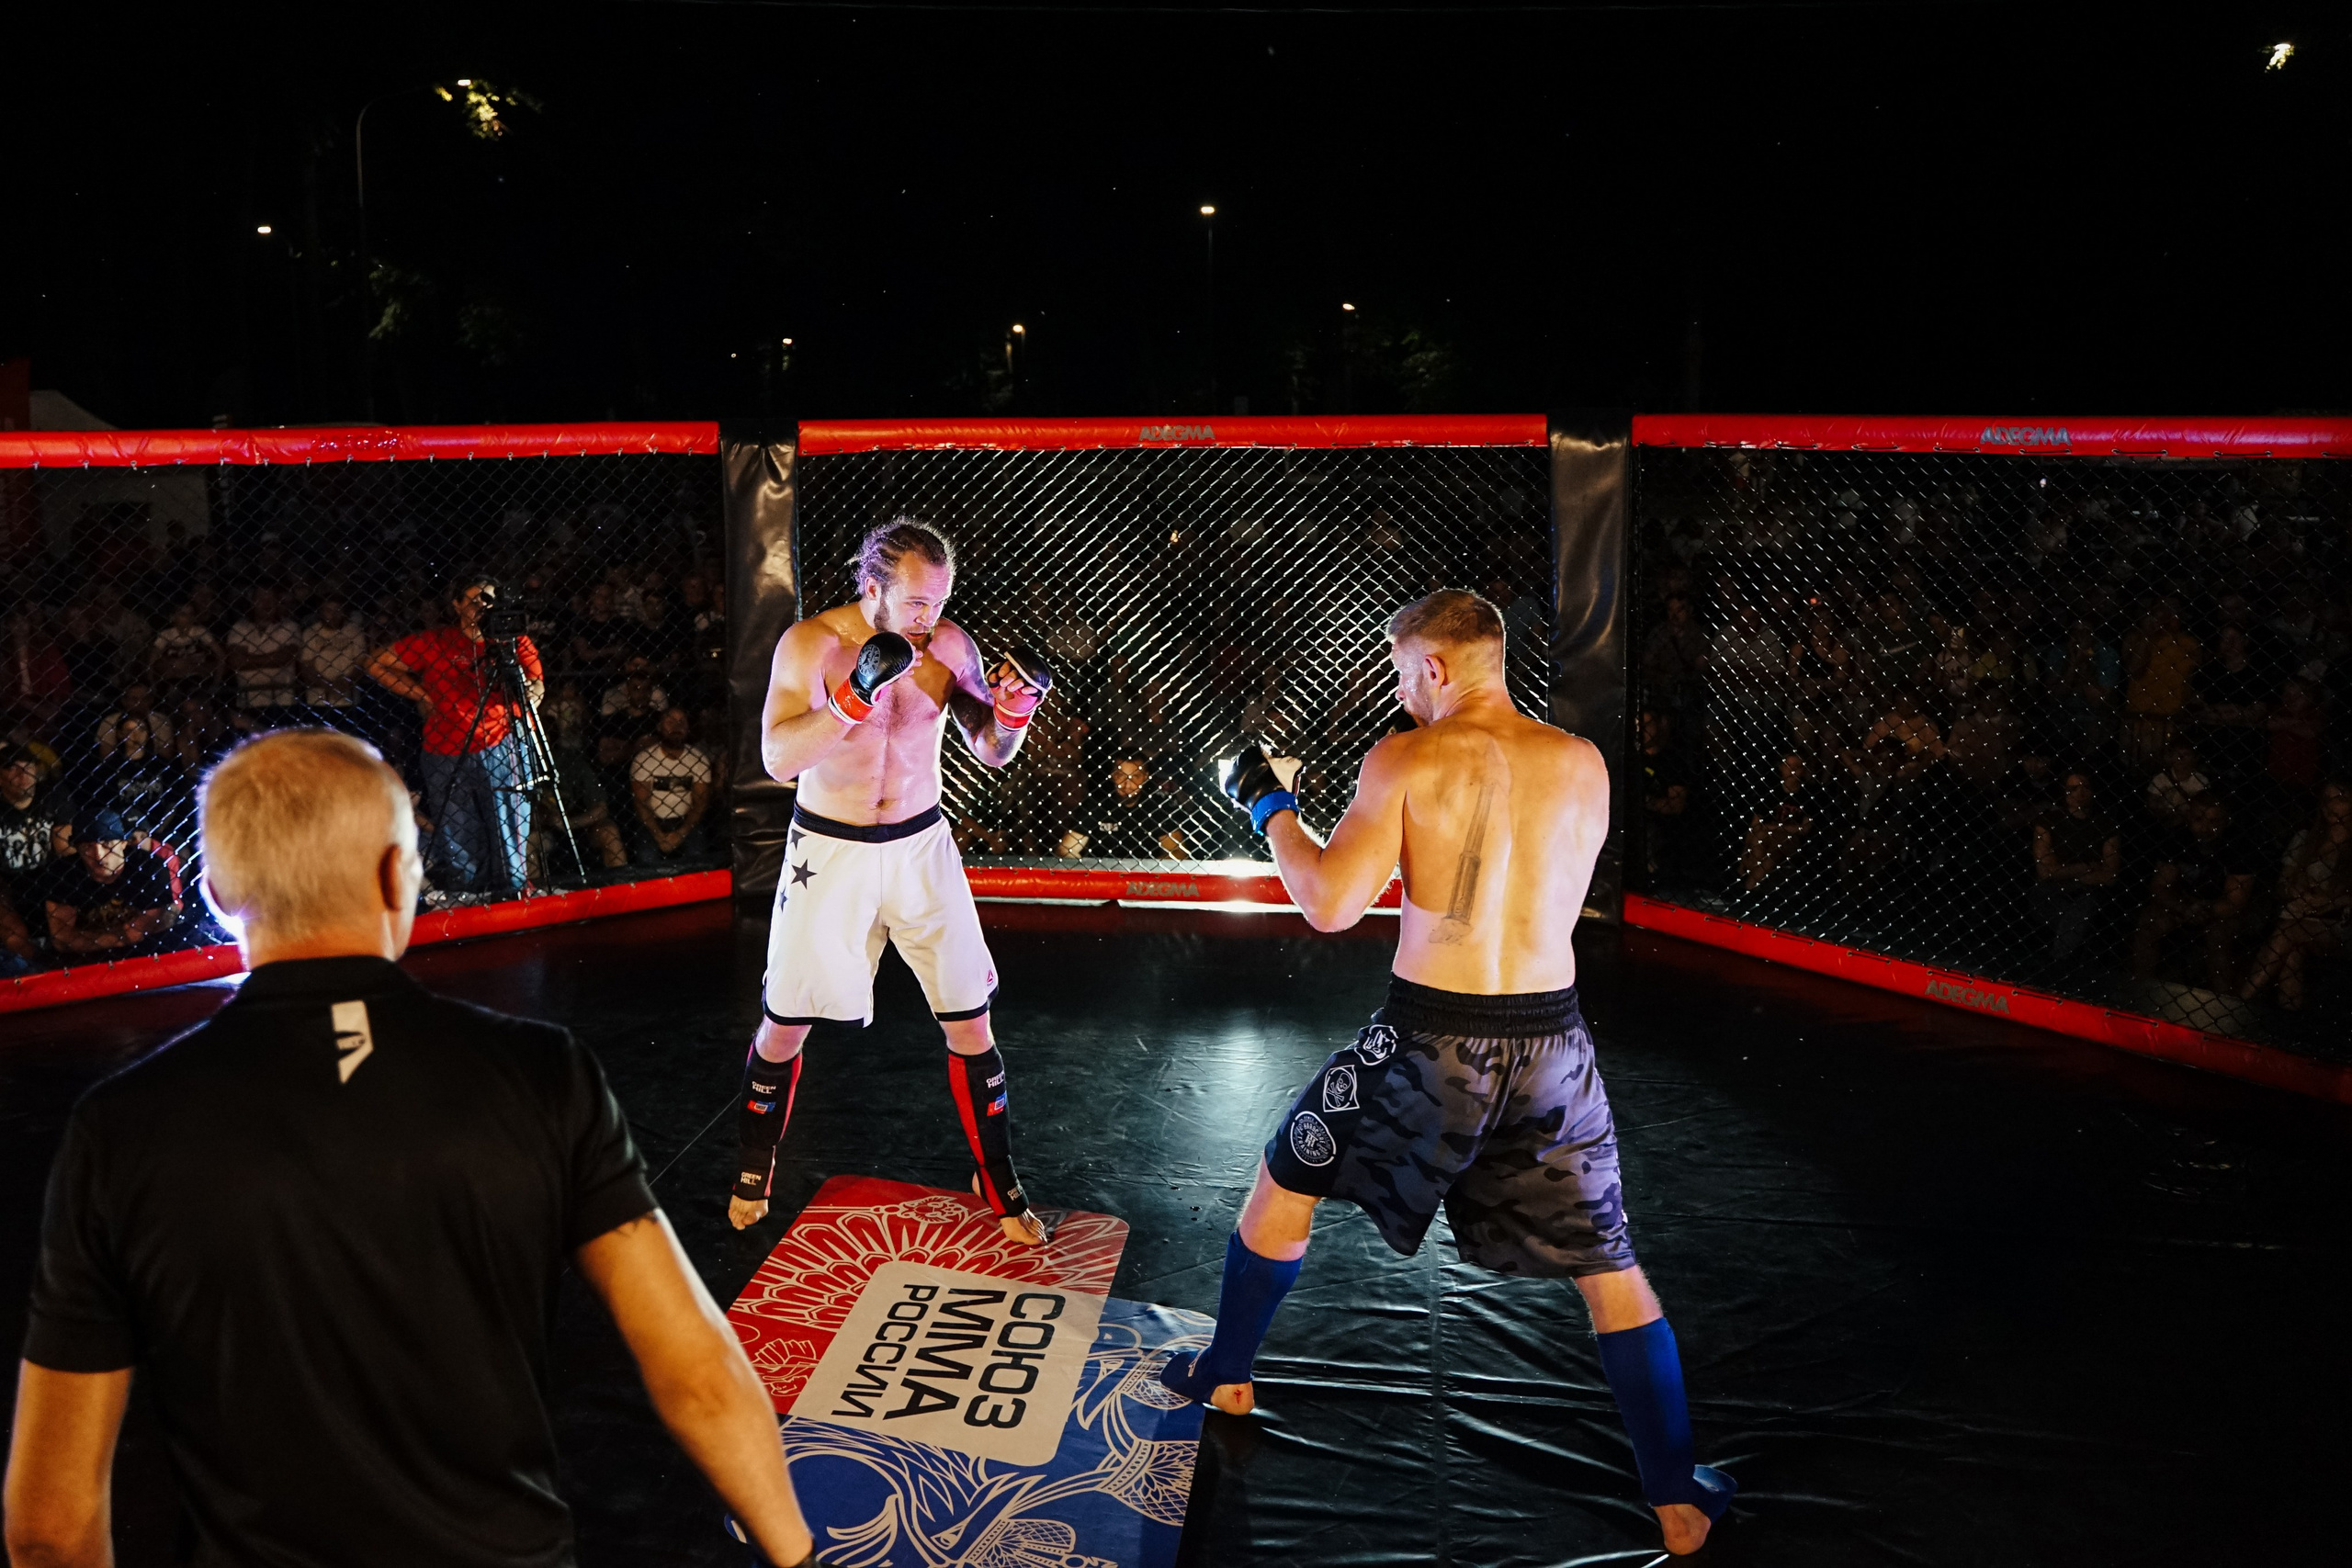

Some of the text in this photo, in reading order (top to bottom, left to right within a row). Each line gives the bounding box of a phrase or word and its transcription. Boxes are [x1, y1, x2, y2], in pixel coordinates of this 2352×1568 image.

[1139, 424, 1216, 441] ADEGMA
[1980, 426, 2073, 446] ADEGMA
[1125, 881, 1200, 897] ADEGMA
[1925, 979, 2010, 1014] ADEGMA
[741, 1171, 762, 1181] GREEN
[741, 1176, 757, 1186] HILL
[831, 1283, 939, 1418] РОССИИ
[882, 1288, 1008, 1420] ММА
[964, 1292, 1066, 1428] СОЮЗ
